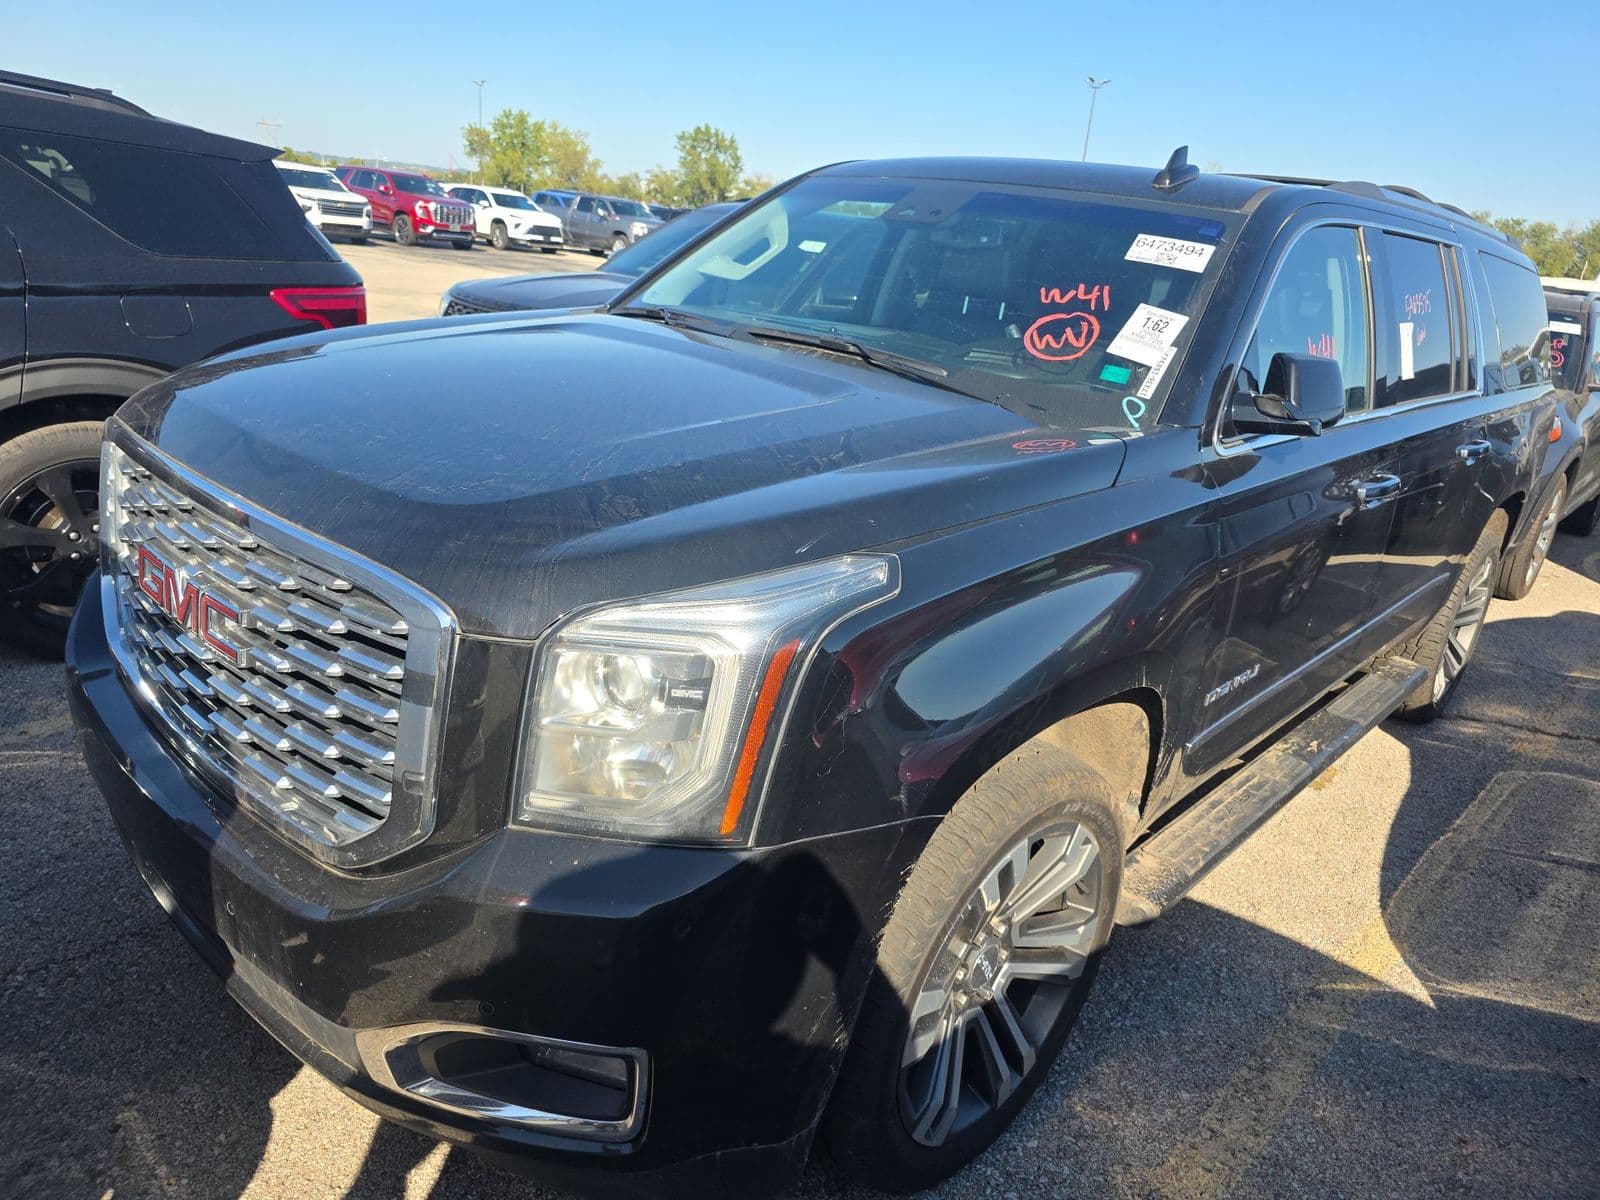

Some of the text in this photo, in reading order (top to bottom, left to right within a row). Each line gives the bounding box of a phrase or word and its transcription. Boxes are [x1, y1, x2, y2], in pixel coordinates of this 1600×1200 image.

[1135, 237, 1205, 258] 6473494
[1142, 316, 1170, 334] 1:62
[138, 544, 247, 668] GMC
[670, 686, 704, 698] GMC
